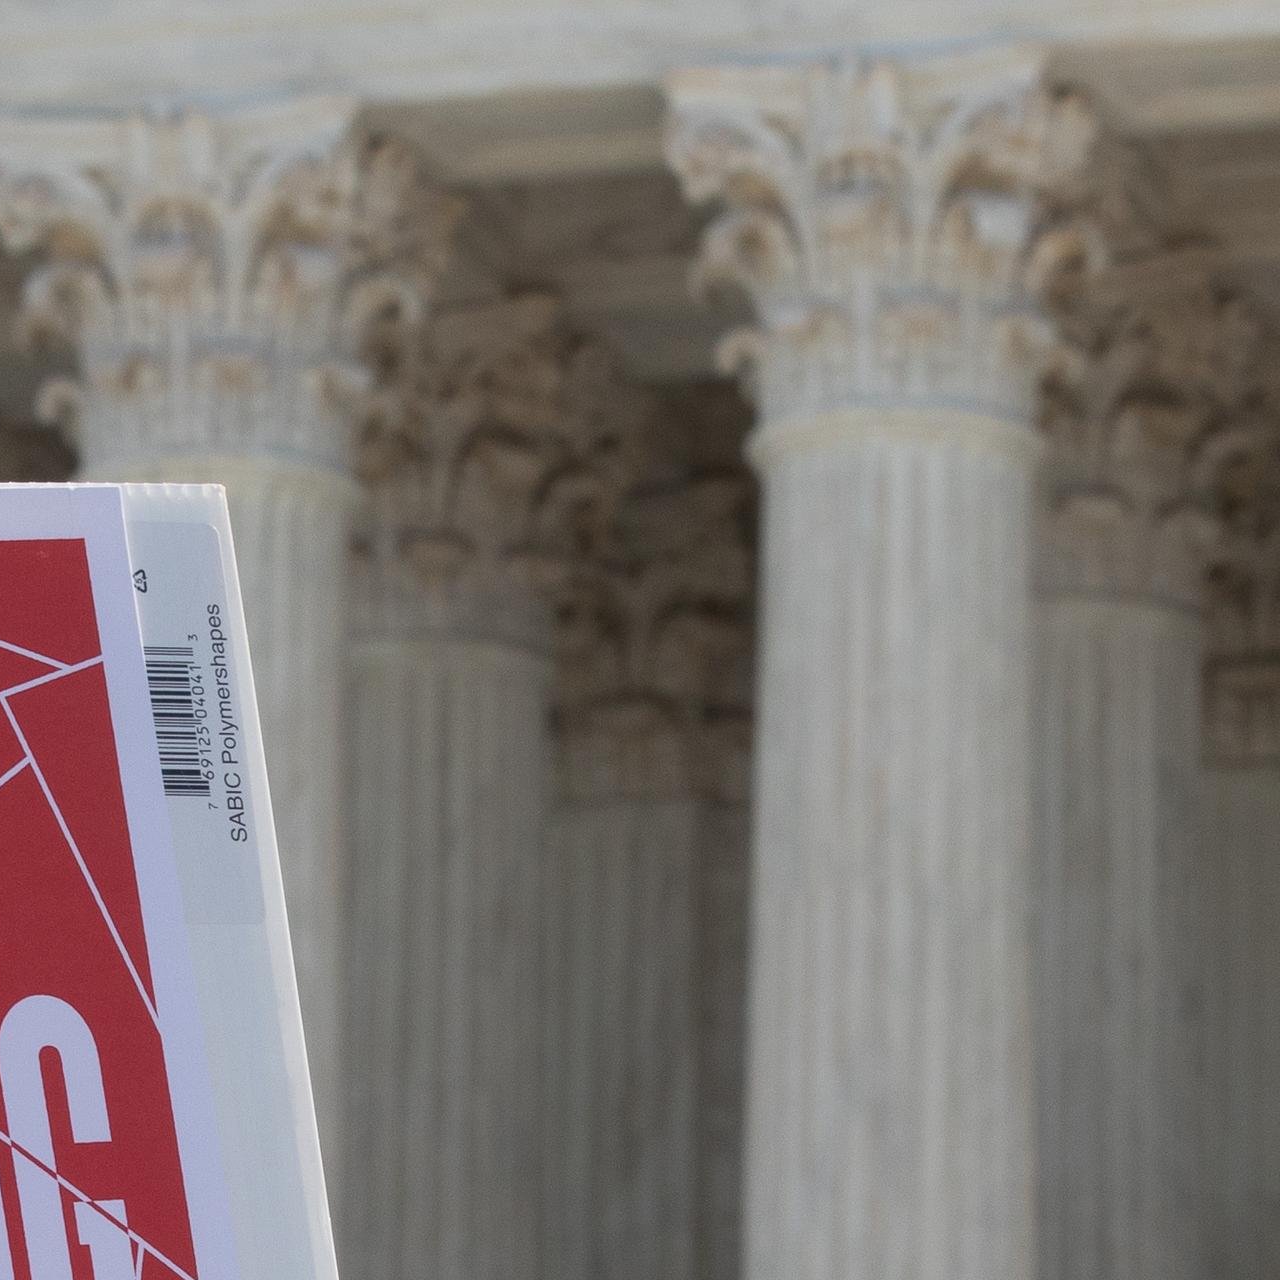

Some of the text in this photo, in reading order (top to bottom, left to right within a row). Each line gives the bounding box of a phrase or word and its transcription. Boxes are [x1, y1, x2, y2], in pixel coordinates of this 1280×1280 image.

[190, 665, 207, 719] 04041
[207, 603, 248, 843] SABIC Polymershapes
[198, 726, 215, 780] 69125
